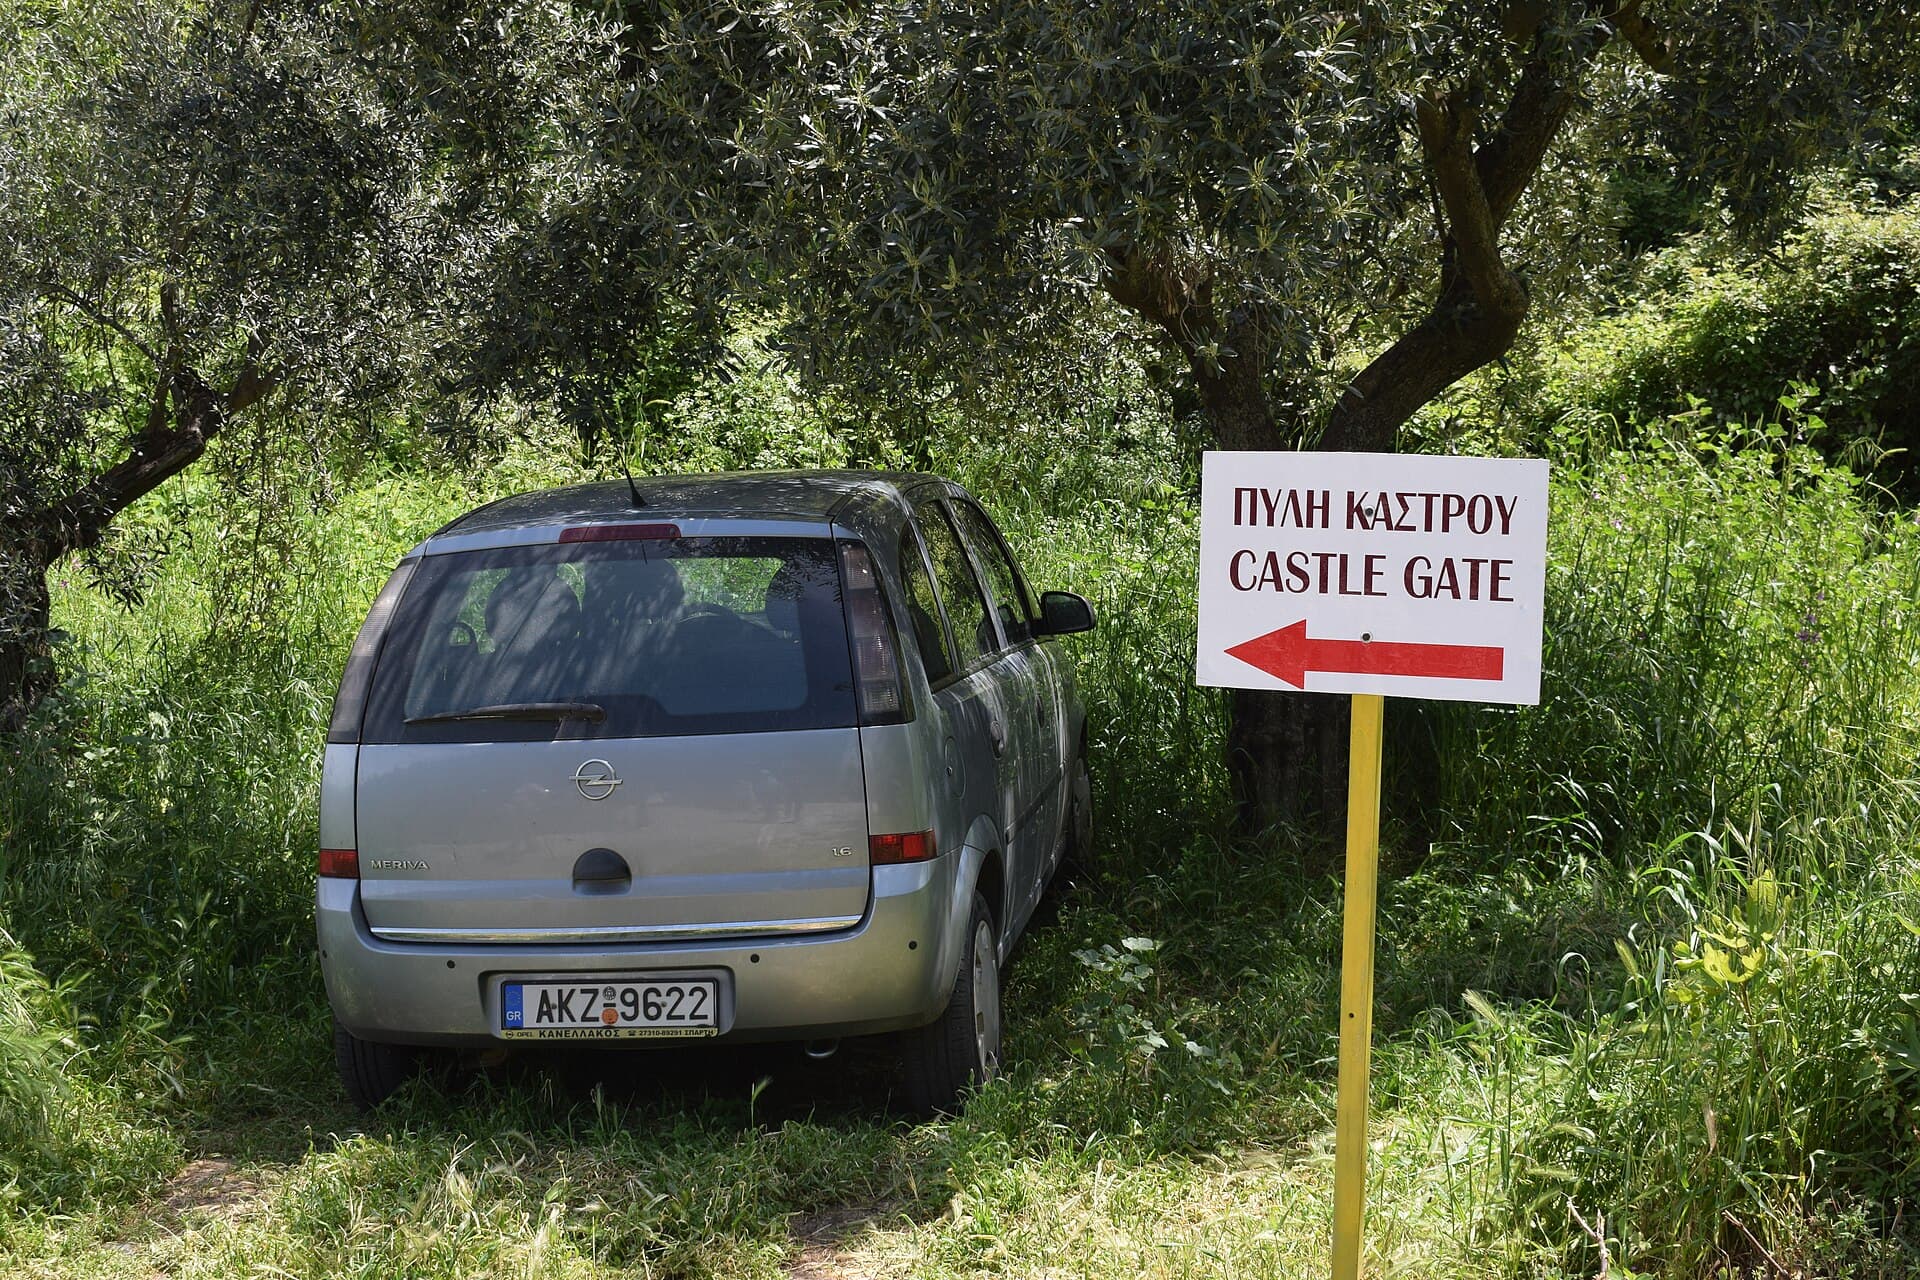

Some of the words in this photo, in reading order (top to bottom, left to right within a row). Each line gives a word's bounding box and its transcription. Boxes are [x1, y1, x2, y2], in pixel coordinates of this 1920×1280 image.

[1233, 487, 1330, 529] ΠΥΛΗ
[1345, 490, 1519, 536] ΚΑΣΤΡΟΥ
[1228, 549, 1388, 597] CASTLE
[1403, 556, 1514, 602] GATE
[370, 859, 430, 870] MERIVA
[506, 1011, 522, 1021] GR
[538, 1029, 621, 1038] ΚΑΝΕΛΛΑΚΟΣ
